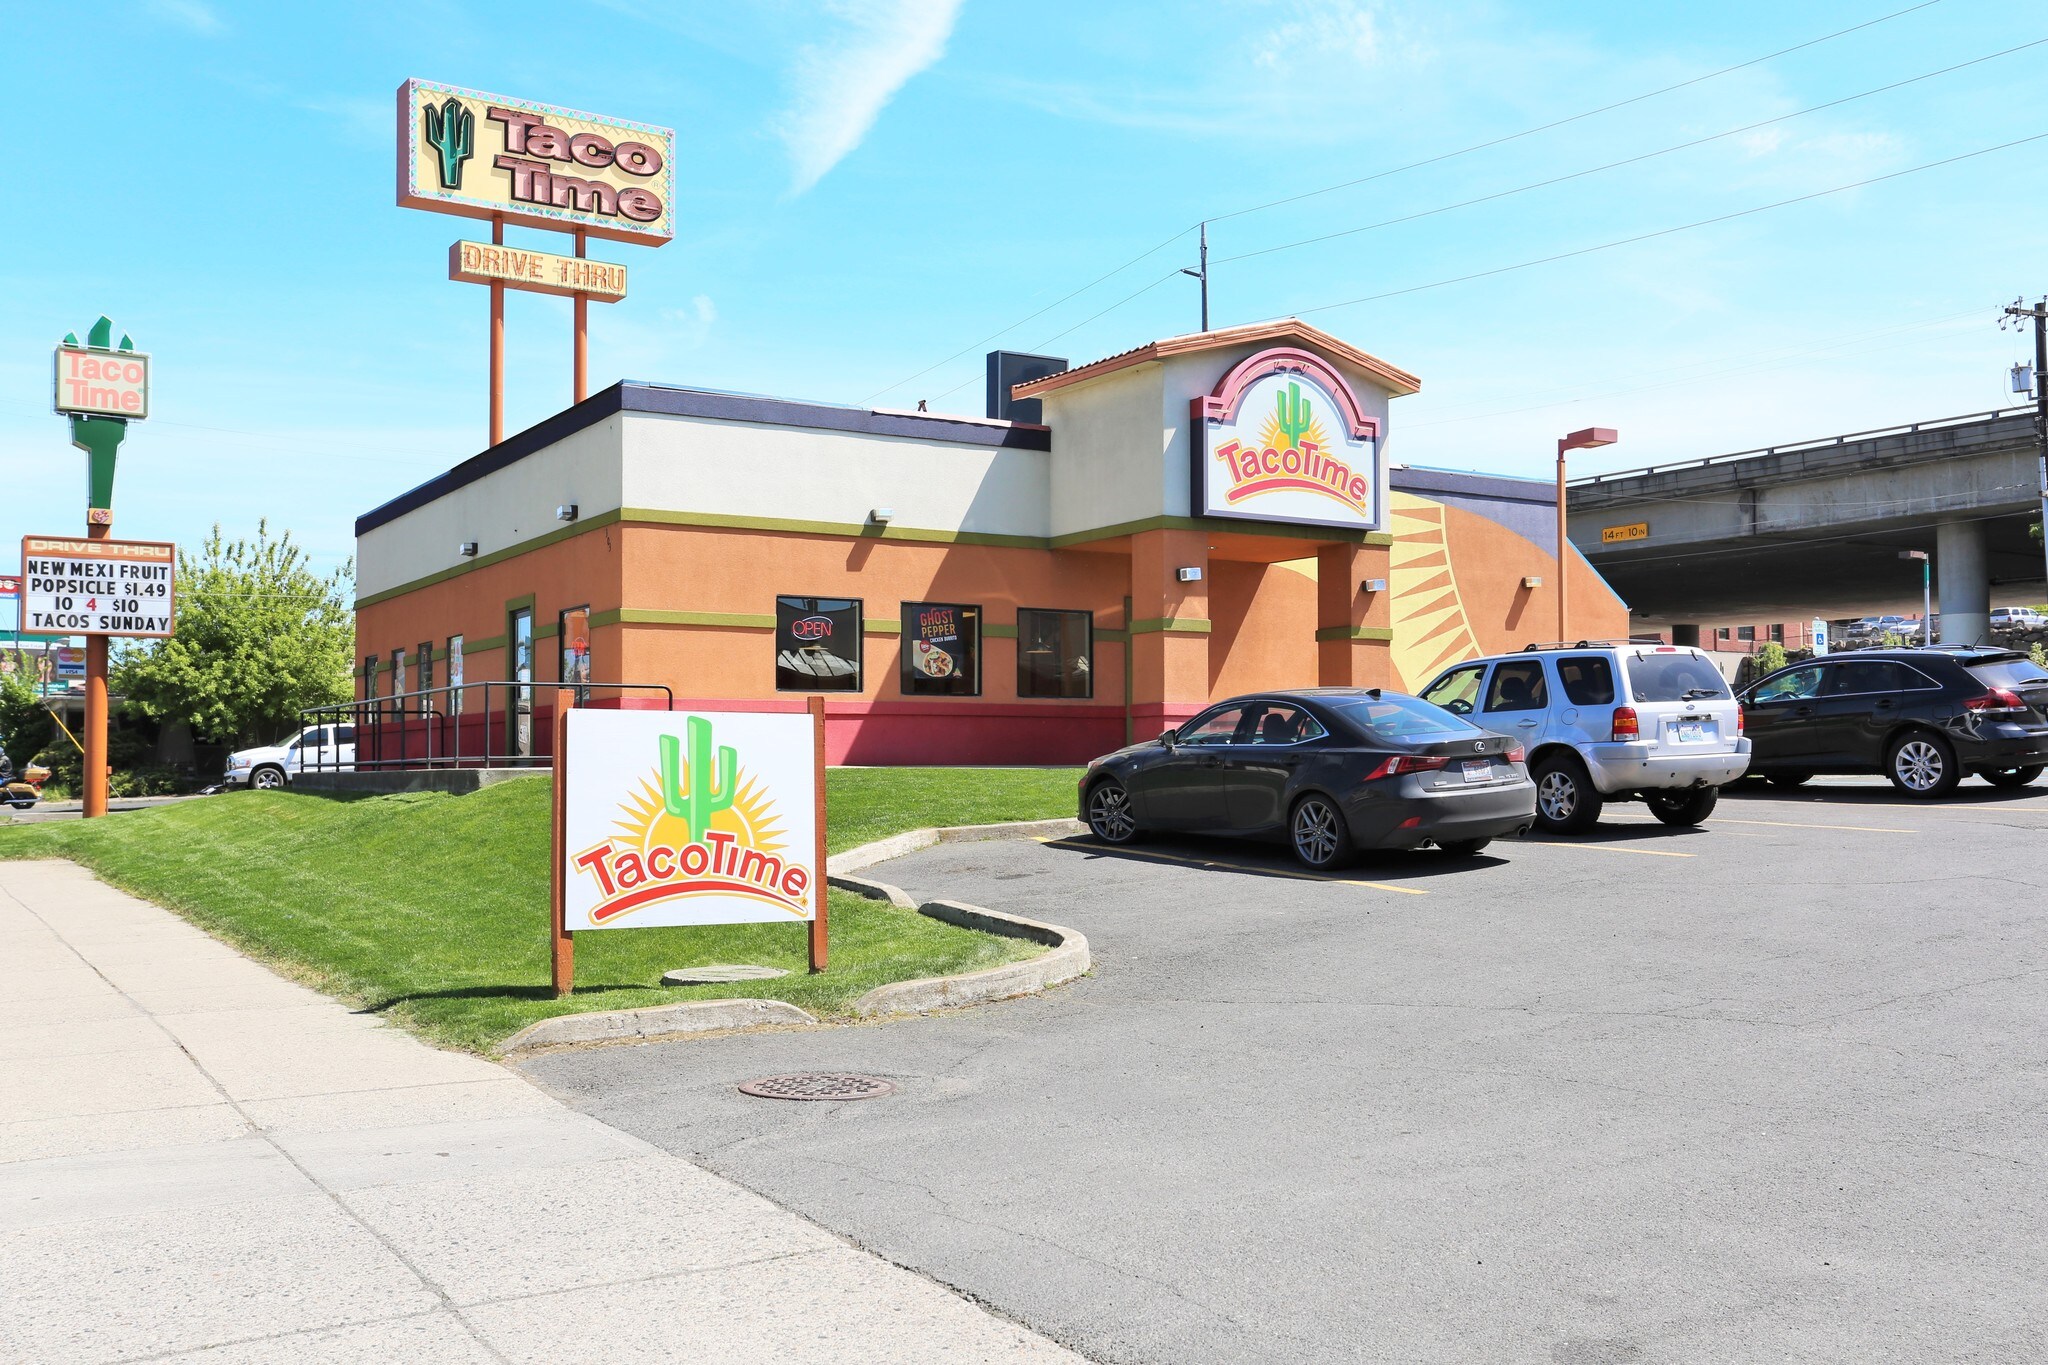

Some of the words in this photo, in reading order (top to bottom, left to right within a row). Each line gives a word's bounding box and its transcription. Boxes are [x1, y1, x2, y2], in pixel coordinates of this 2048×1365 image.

[486, 105, 663, 177] Taco
[492, 154, 663, 222] Time
[463, 244, 544, 279] DRIVE
[556, 258, 625, 292] THRU
[63, 350, 144, 384] Taco
[65, 379, 140, 411] Time
[1216, 439, 1368, 501] TacoTime
[30, 540, 102, 553] DRIVE
[108, 544, 170, 556] THRU
[28, 560, 65, 576] NEW
[70, 562, 114, 577] MEXI
[120, 564, 168, 580] FRUIT
[31, 578, 116, 595] POPSICLE
[124, 582, 166, 597] $1.49
[55, 596, 73, 610] 10
[86, 597, 97, 611] 4
[112, 599, 139, 613] $10
[33, 613, 90, 628] TACOS
[99, 615, 169, 631] SUNDAY
[920, 608, 954, 627] GHOST
[792, 620, 832, 637] OPEN
[921, 624, 956, 639] PEPPER
[577, 832, 807, 896] TacoTime
